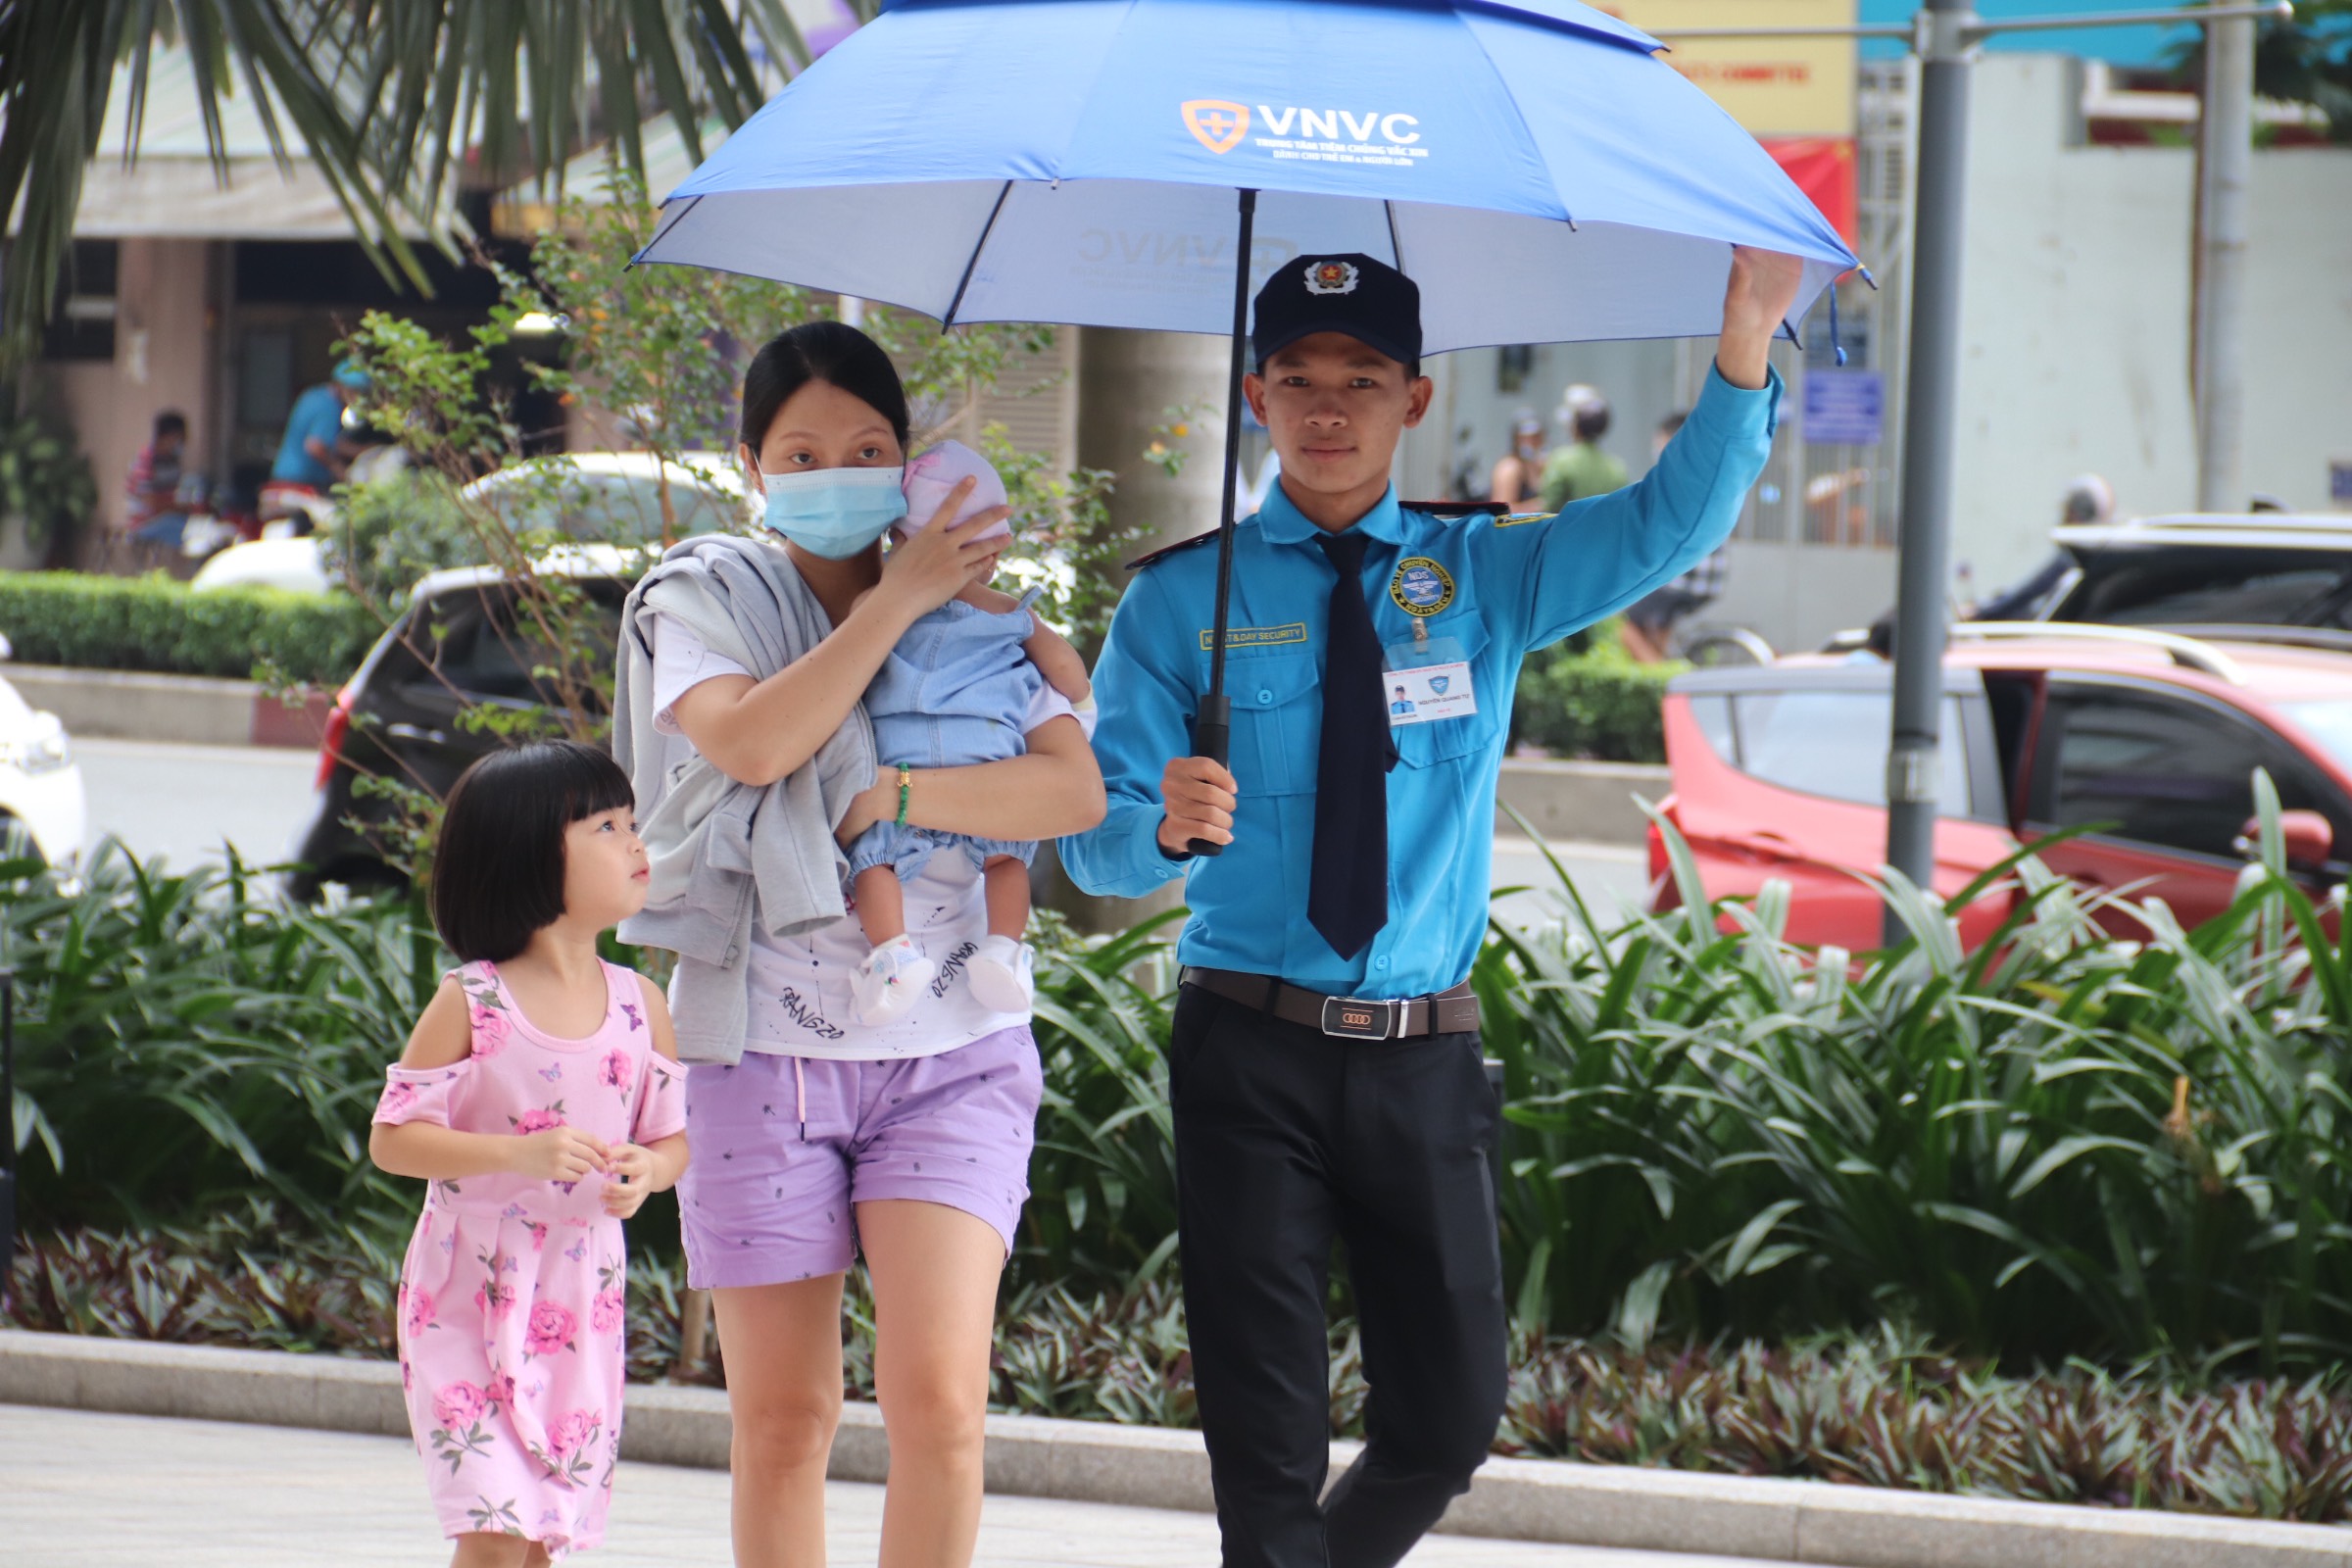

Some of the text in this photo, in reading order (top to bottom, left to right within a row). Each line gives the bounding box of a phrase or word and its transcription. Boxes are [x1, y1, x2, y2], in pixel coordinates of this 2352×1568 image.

[1256, 105, 1422, 144] VNVC
[1407, 570, 1429, 581] NDS
[1257, 628, 1300, 640] SECURITY
